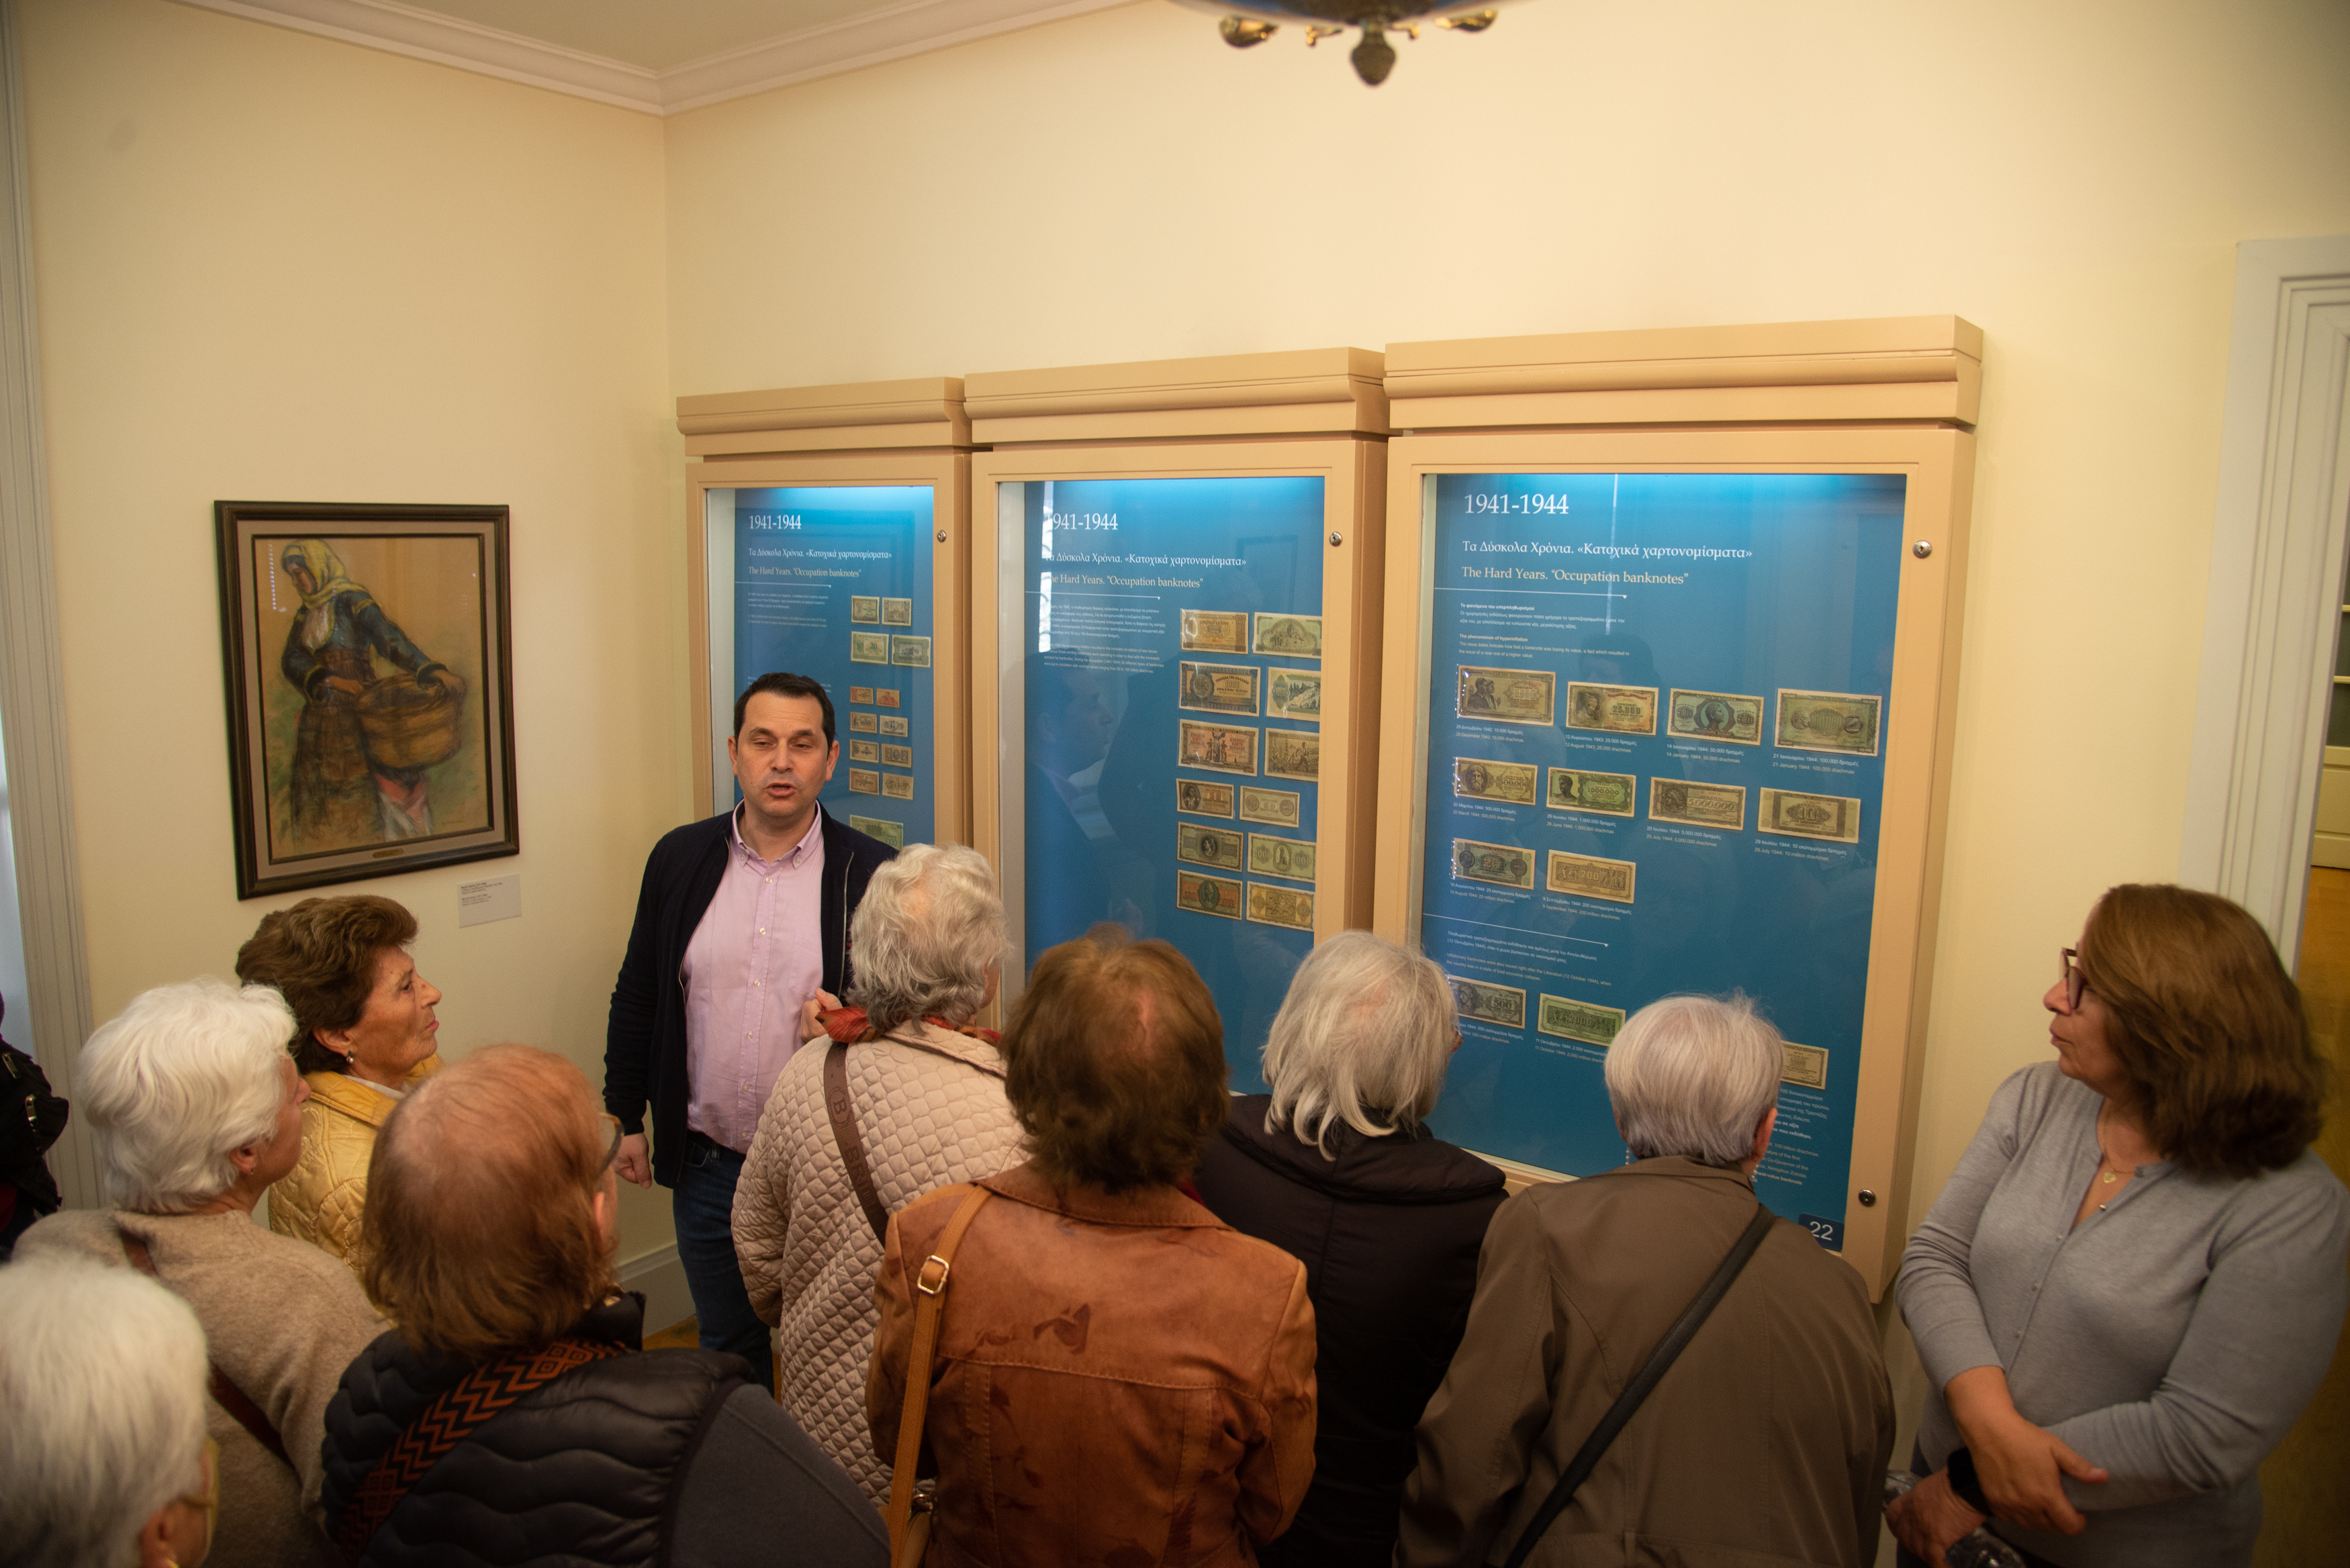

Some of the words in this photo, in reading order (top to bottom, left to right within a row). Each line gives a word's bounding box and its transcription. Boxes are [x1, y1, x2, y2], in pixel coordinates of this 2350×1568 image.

[1464, 493, 1568, 514] 1941-1944
[749, 515, 802, 530] 1941-1944
[748, 548, 756, 556] Τα
[757, 548, 782, 556] Δύσκολα
[1462, 540, 1477, 552] Τα
[1479, 540, 1527, 553] Δύσκολα
[1531, 541, 1574, 556] Χρόνια.
[1577, 542, 1640, 558] «Κατοχικά
[1642, 546, 1752, 562] χαρτονομίσματα»
[1056, 552, 1090, 562] Δύσκολα
[1092, 553, 1123, 566] Χρόνια.
[1124, 554, 1168, 567] «Κατοχικά
[1170, 555, 1246, 569] χαρτονομίσματα»
[749, 566, 759, 575] The
[759, 567, 774, 575] Hard
[775, 567, 792, 575] Years.
[1462, 566, 1482, 578] The
[1485, 567, 1512, 579] Hard
[1515, 568, 1548, 580] Years.
[1552, 569, 1620, 585] “Occupation
[1623, 571, 1689, 585] banknotes”
[1060, 574, 1080, 583] Hard
[1082, 575, 1104, 585] Years.
[1809, 1220, 1834, 1241] 22
